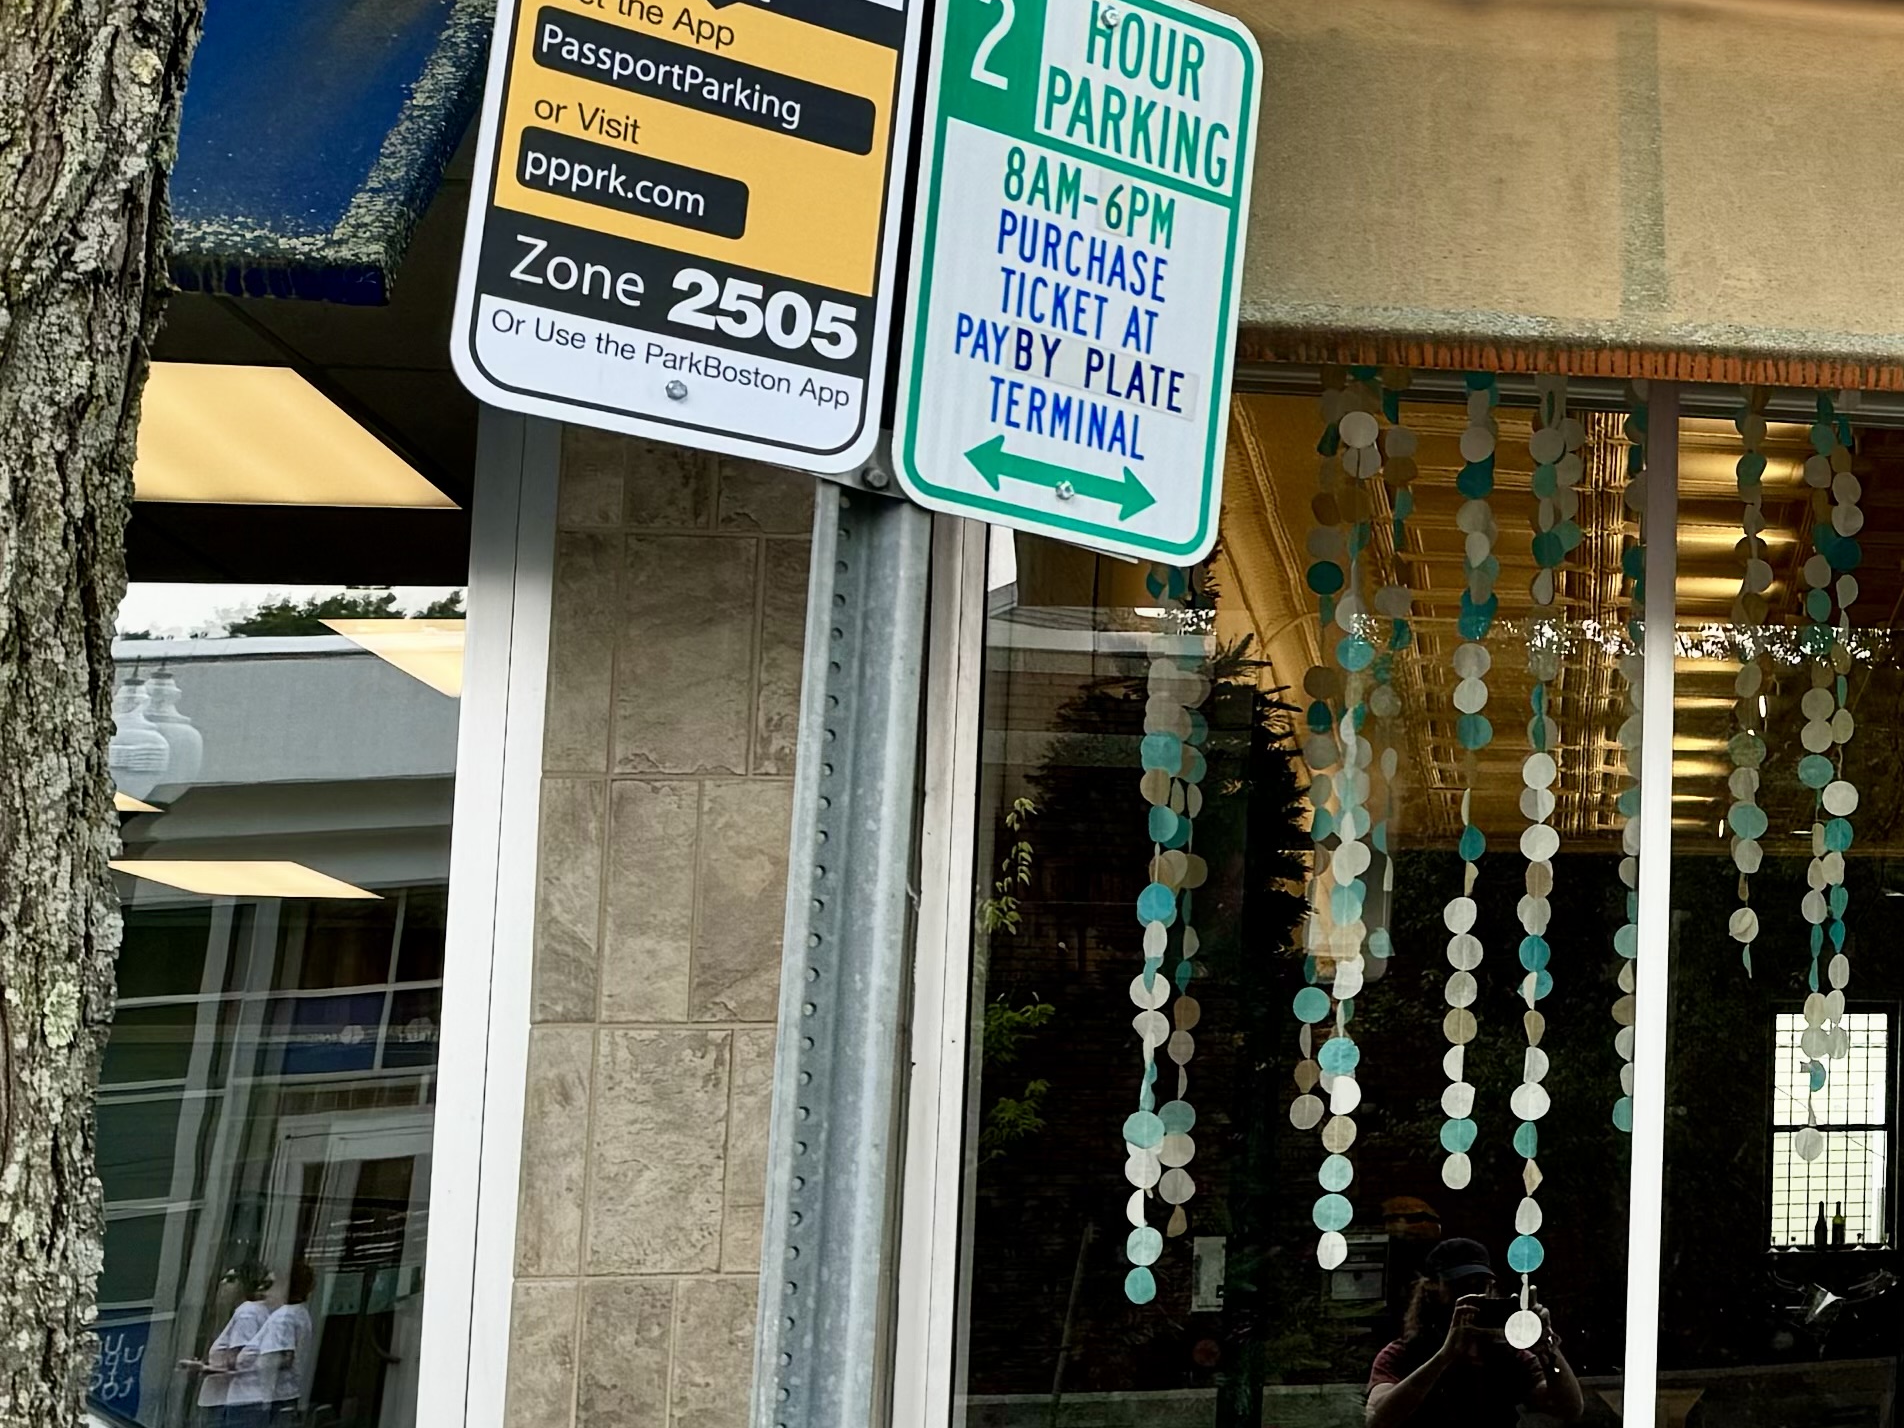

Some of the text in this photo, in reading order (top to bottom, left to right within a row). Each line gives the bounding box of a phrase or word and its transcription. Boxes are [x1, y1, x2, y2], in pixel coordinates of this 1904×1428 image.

[672, 6, 735, 49] App
[1086, 0, 1205, 102] HOUR
[534, 97, 641, 146] or Visit
[541, 24, 801, 130] PassportParking
[1043, 65, 1230, 189] PARKING
[525, 146, 706, 217] ppprk.com
[509, 234, 858, 360] Zone 2505
[997, 208, 1169, 304] PURCHASE
[1001, 266, 1159, 356] TICKET AT
[492, 308, 850, 411] Or Use the ParkBoston App
[1084, 347, 1185, 415] PLATE
[990, 376, 1145, 463] TERMINAL
